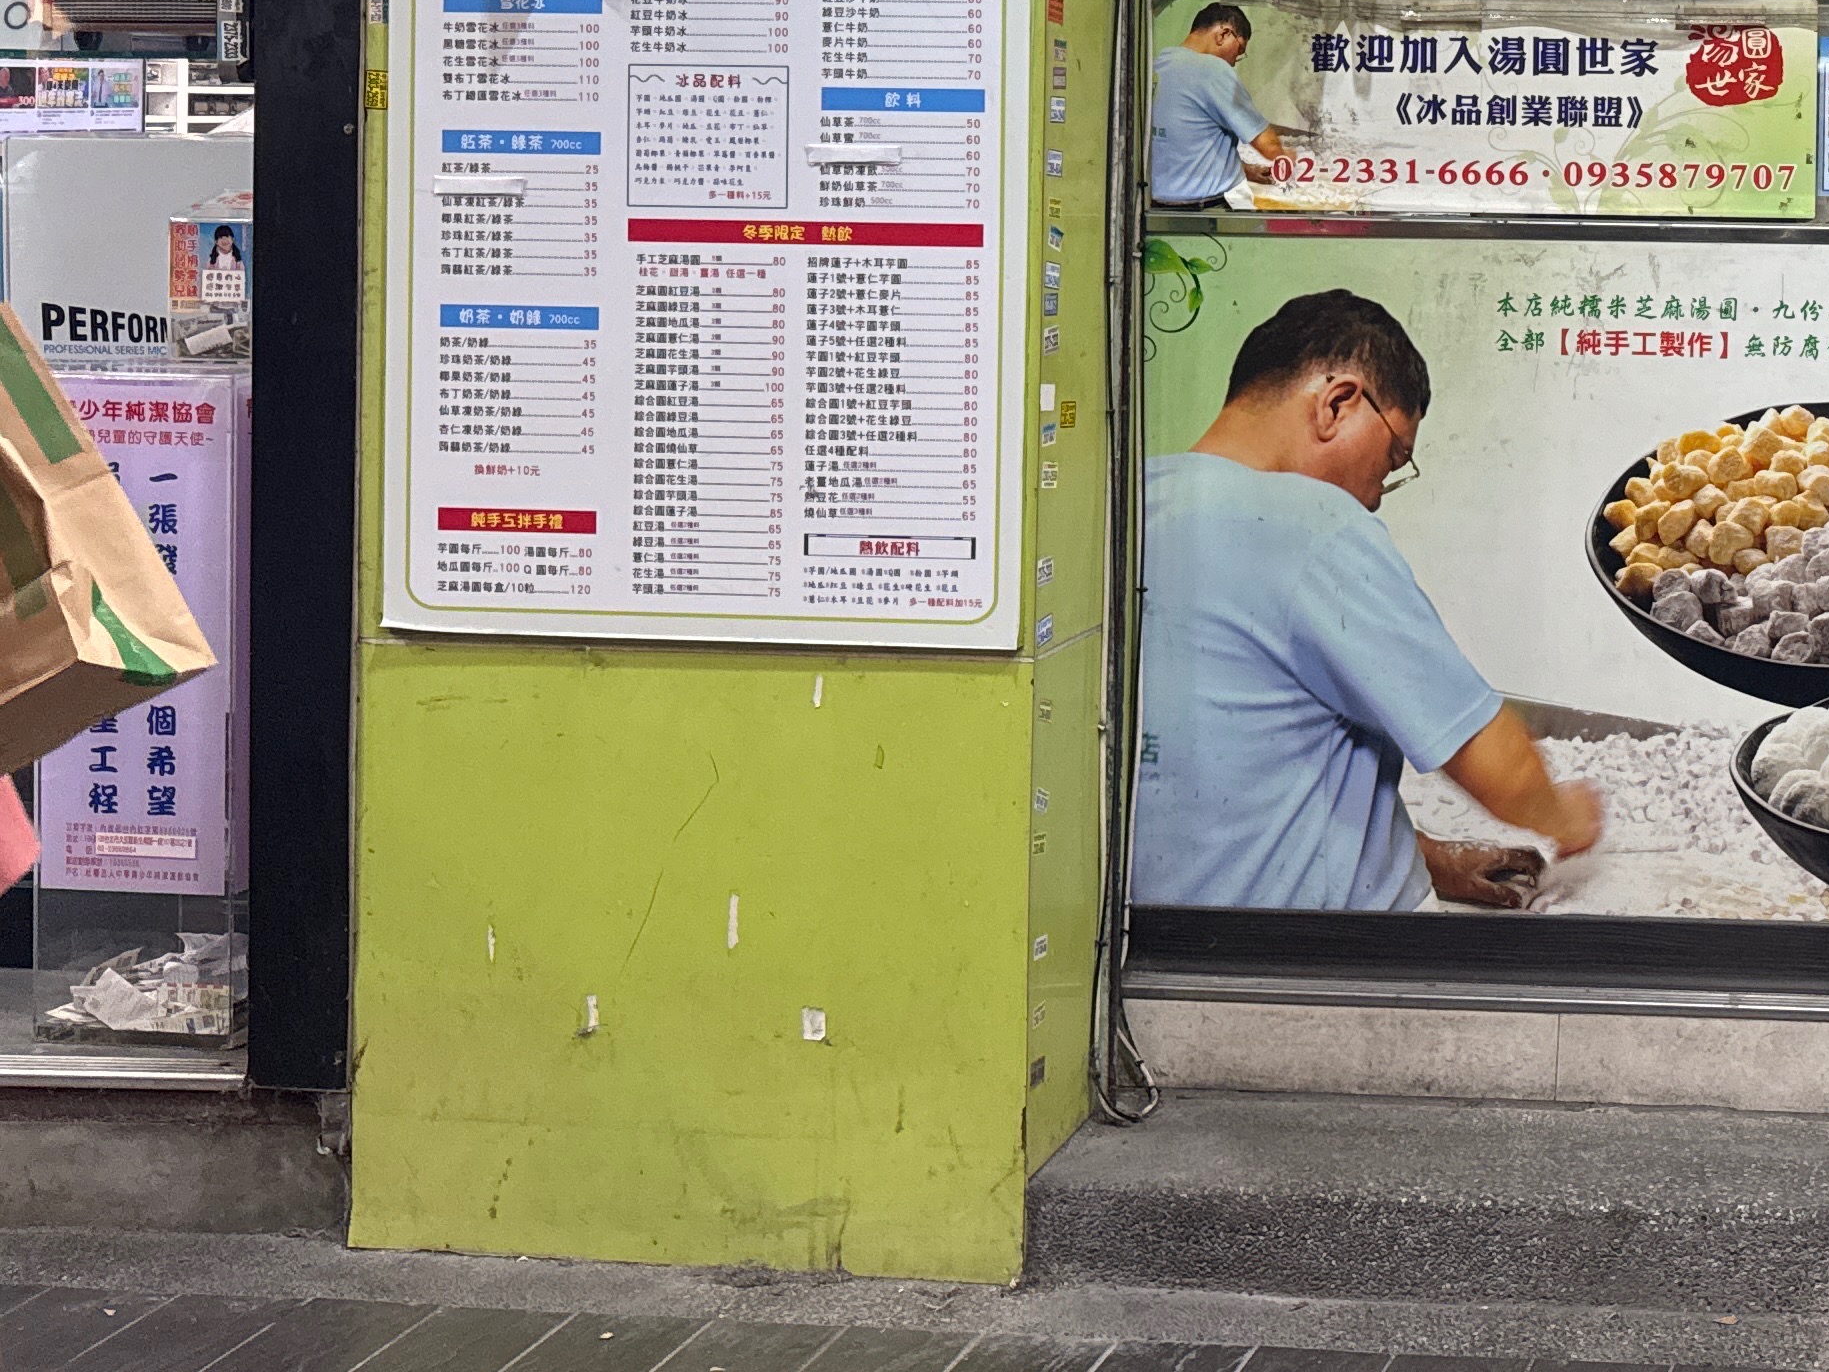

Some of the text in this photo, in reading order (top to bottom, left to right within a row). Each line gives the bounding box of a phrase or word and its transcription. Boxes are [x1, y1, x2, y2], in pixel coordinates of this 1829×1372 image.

[822, 52, 982, 64] 花生牛奶 70
[1311, 33, 1659, 78] 歡迎加入湯圓世家
[578, 75, 600, 85] 110
[676, 73, 742, 89] 冰品配料
[885, 91, 921, 107] 飲料
[1395, 93, 1644, 129] 《冰品創業聯盟》
[966, 118, 981, 129] 50
[550, 139, 582, 150] 700cc
[585, 164, 598, 174] 25
[1271, 156, 1796, 192] 02-2331-6666 0935879707
[966, 199, 980, 209] 70
[742, 224, 853, 242] 冬季限定 熱飲
[773, 256, 786, 266] 80
[548, 314, 580, 325] 700cc
[44, 344, 113, 355] PROFESSIONAL
[115, 344, 145, 355] SERIES
[583, 339, 597, 349] 35
[69, 399, 216, 425] 少年純潔協會
[963, 464, 977, 474] 85
[500, 545, 520, 555] 100
[578, 548, 593, 558] 80
[859, 540, 920, 557] 熱飲配料
[570, 584, 591, 595] 120
